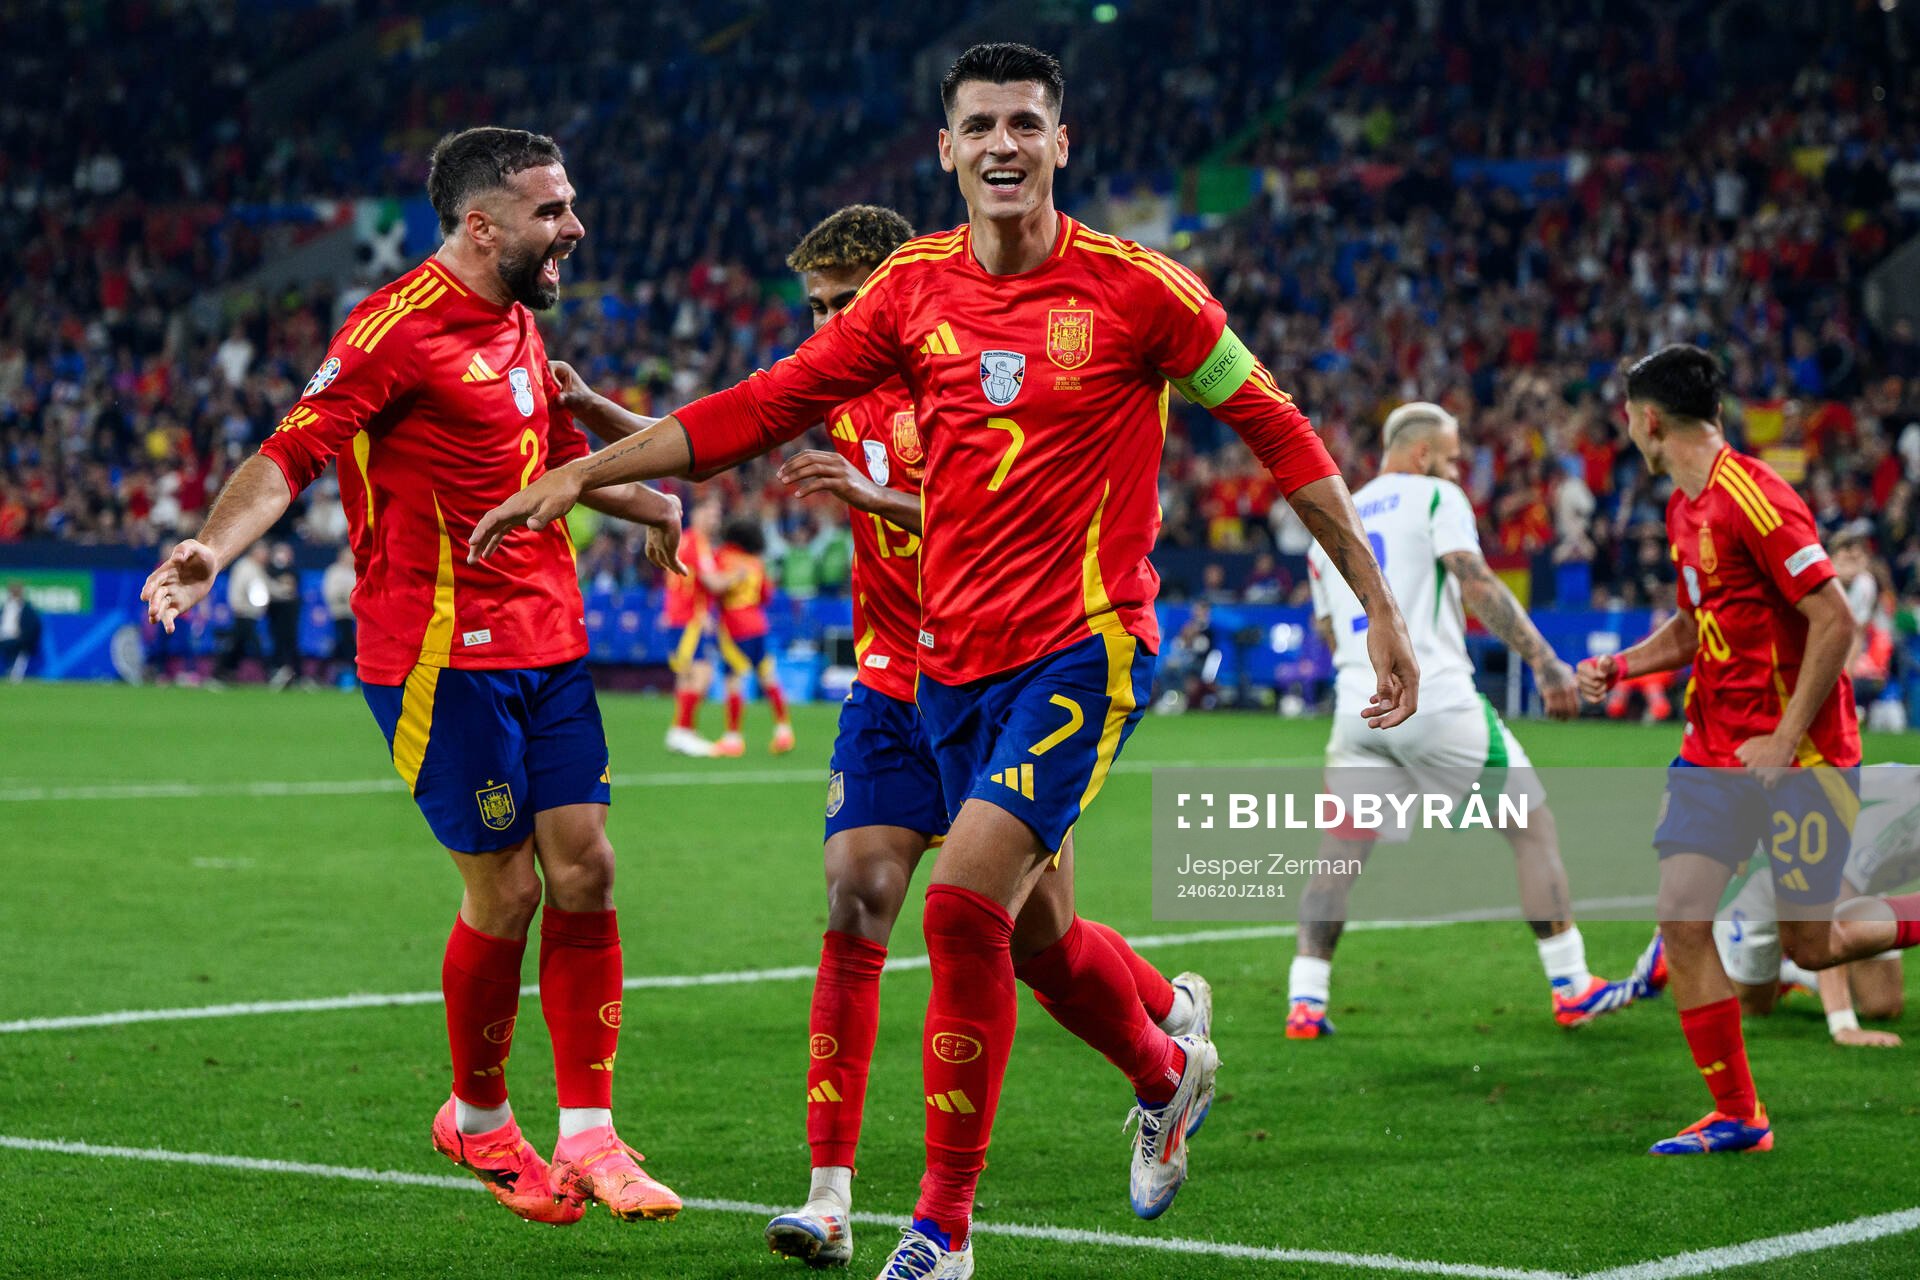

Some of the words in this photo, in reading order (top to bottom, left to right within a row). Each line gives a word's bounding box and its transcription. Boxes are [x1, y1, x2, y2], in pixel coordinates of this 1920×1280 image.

[986, 417, 1025, 492] 7
[1028, 693, 1084, 756] 7
[1771, 810, 1828, 864] 20
